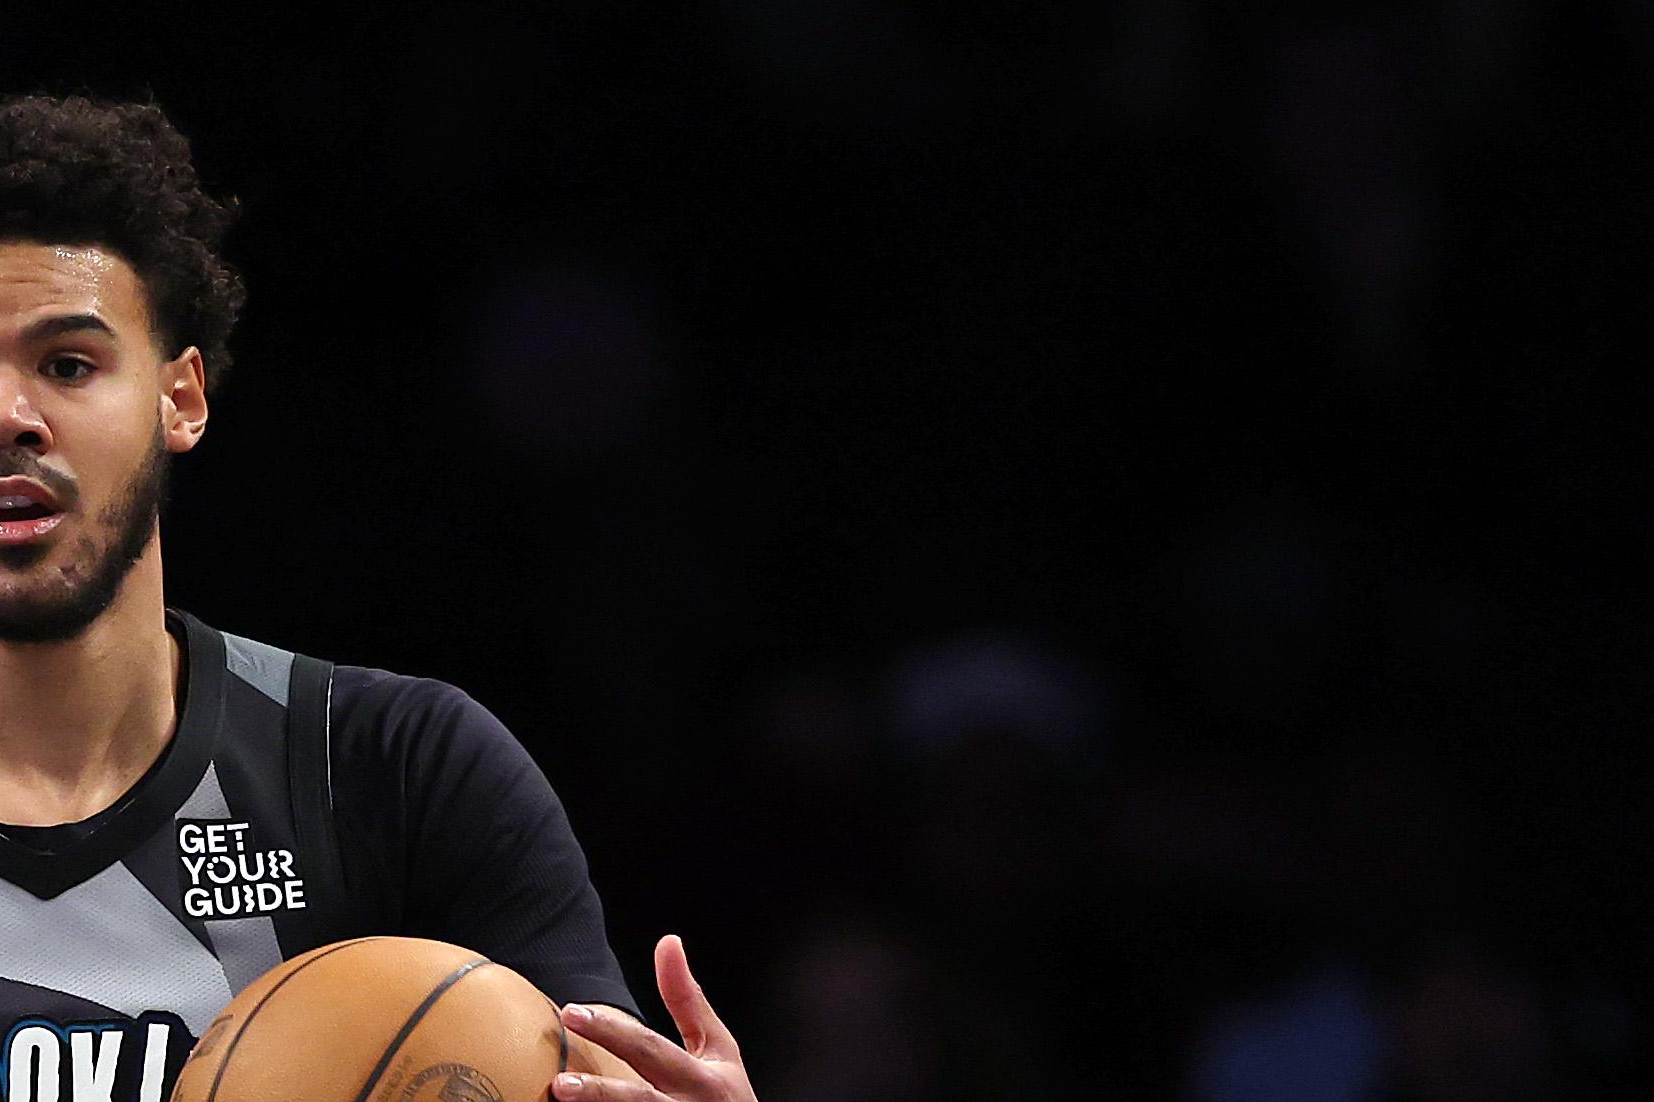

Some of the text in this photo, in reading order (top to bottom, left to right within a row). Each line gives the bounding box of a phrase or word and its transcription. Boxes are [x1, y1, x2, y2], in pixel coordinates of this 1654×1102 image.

[179, 822, 249, 854] GET
[180, 849, 296, 885] YOUR
[184, 879, 306, 917] GUIDE
